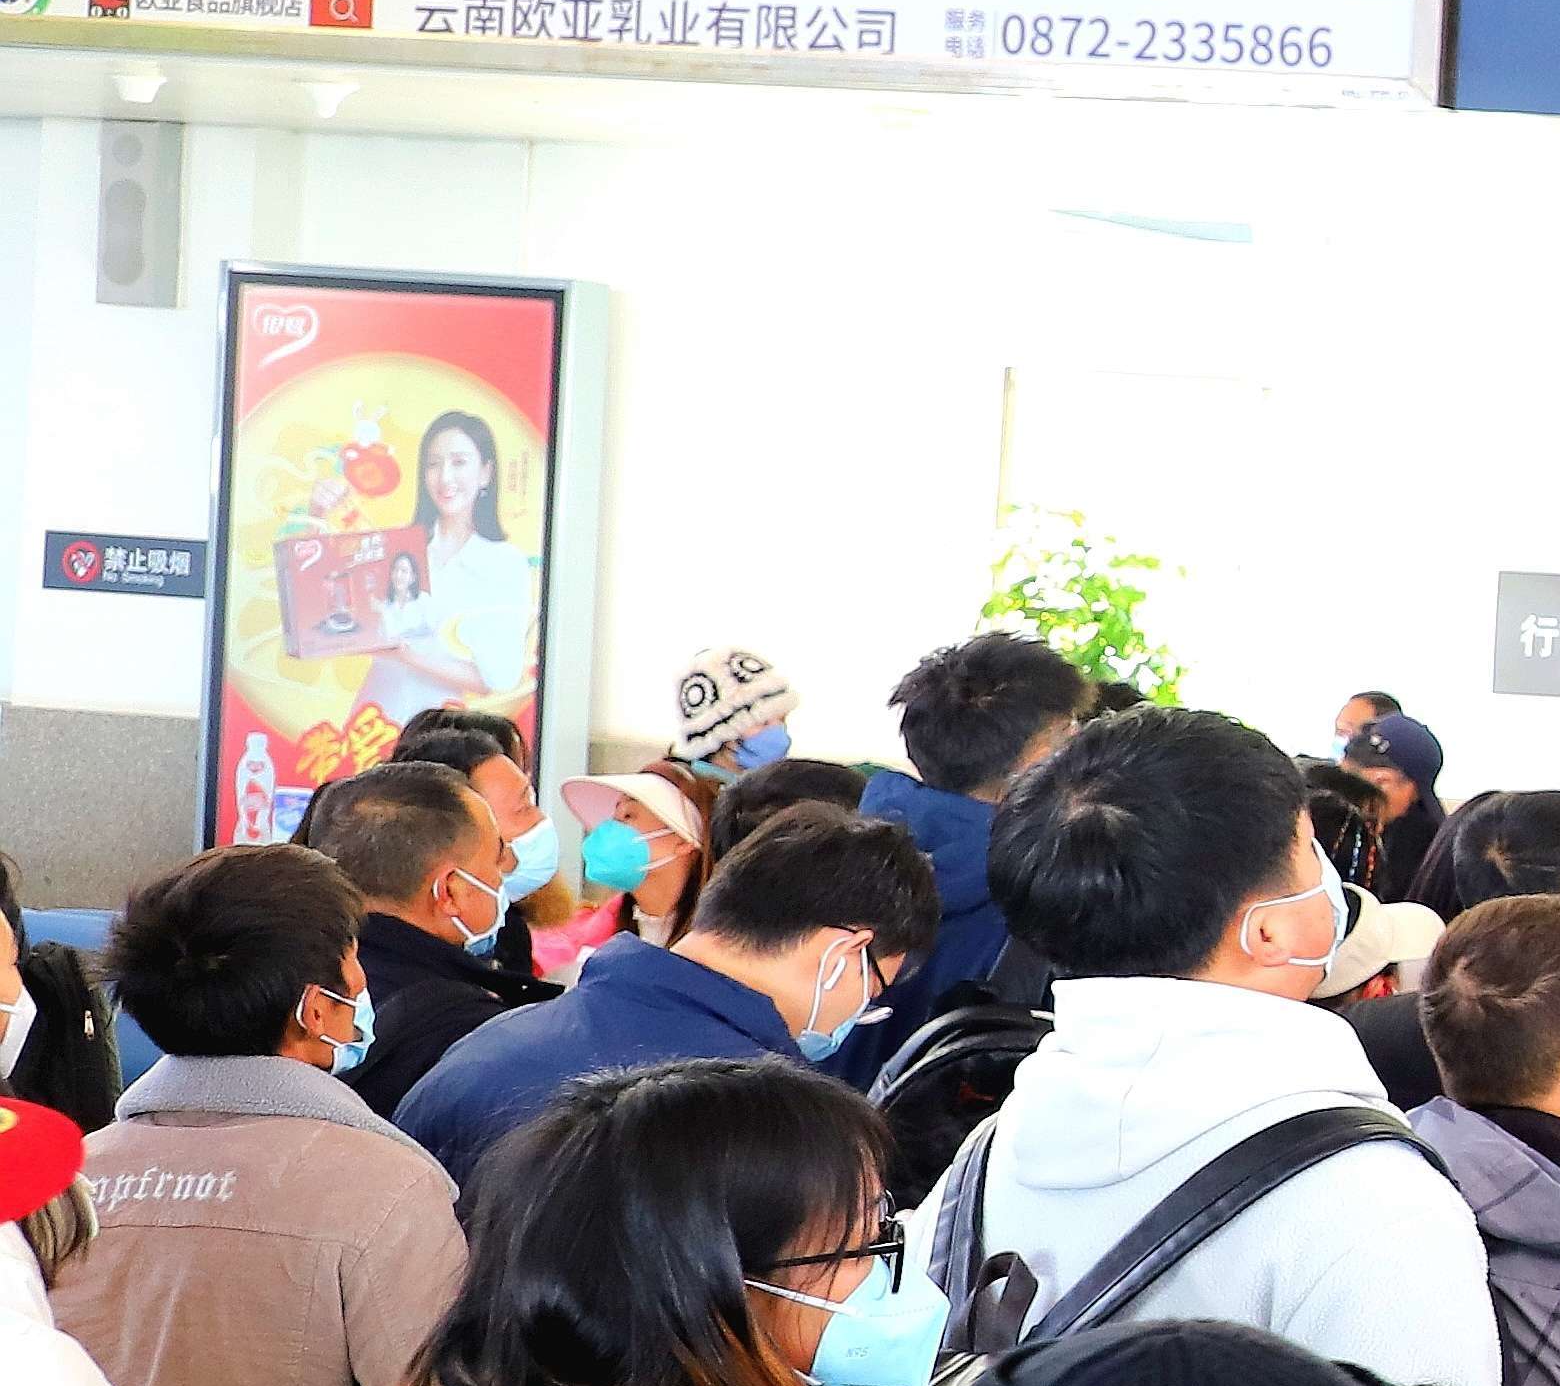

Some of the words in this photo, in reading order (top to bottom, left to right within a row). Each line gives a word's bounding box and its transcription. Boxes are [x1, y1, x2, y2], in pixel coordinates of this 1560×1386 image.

[1002, 13, 1334, 67] 0872-2335866
[103, 545, 192, 577] 禁止吸烟
